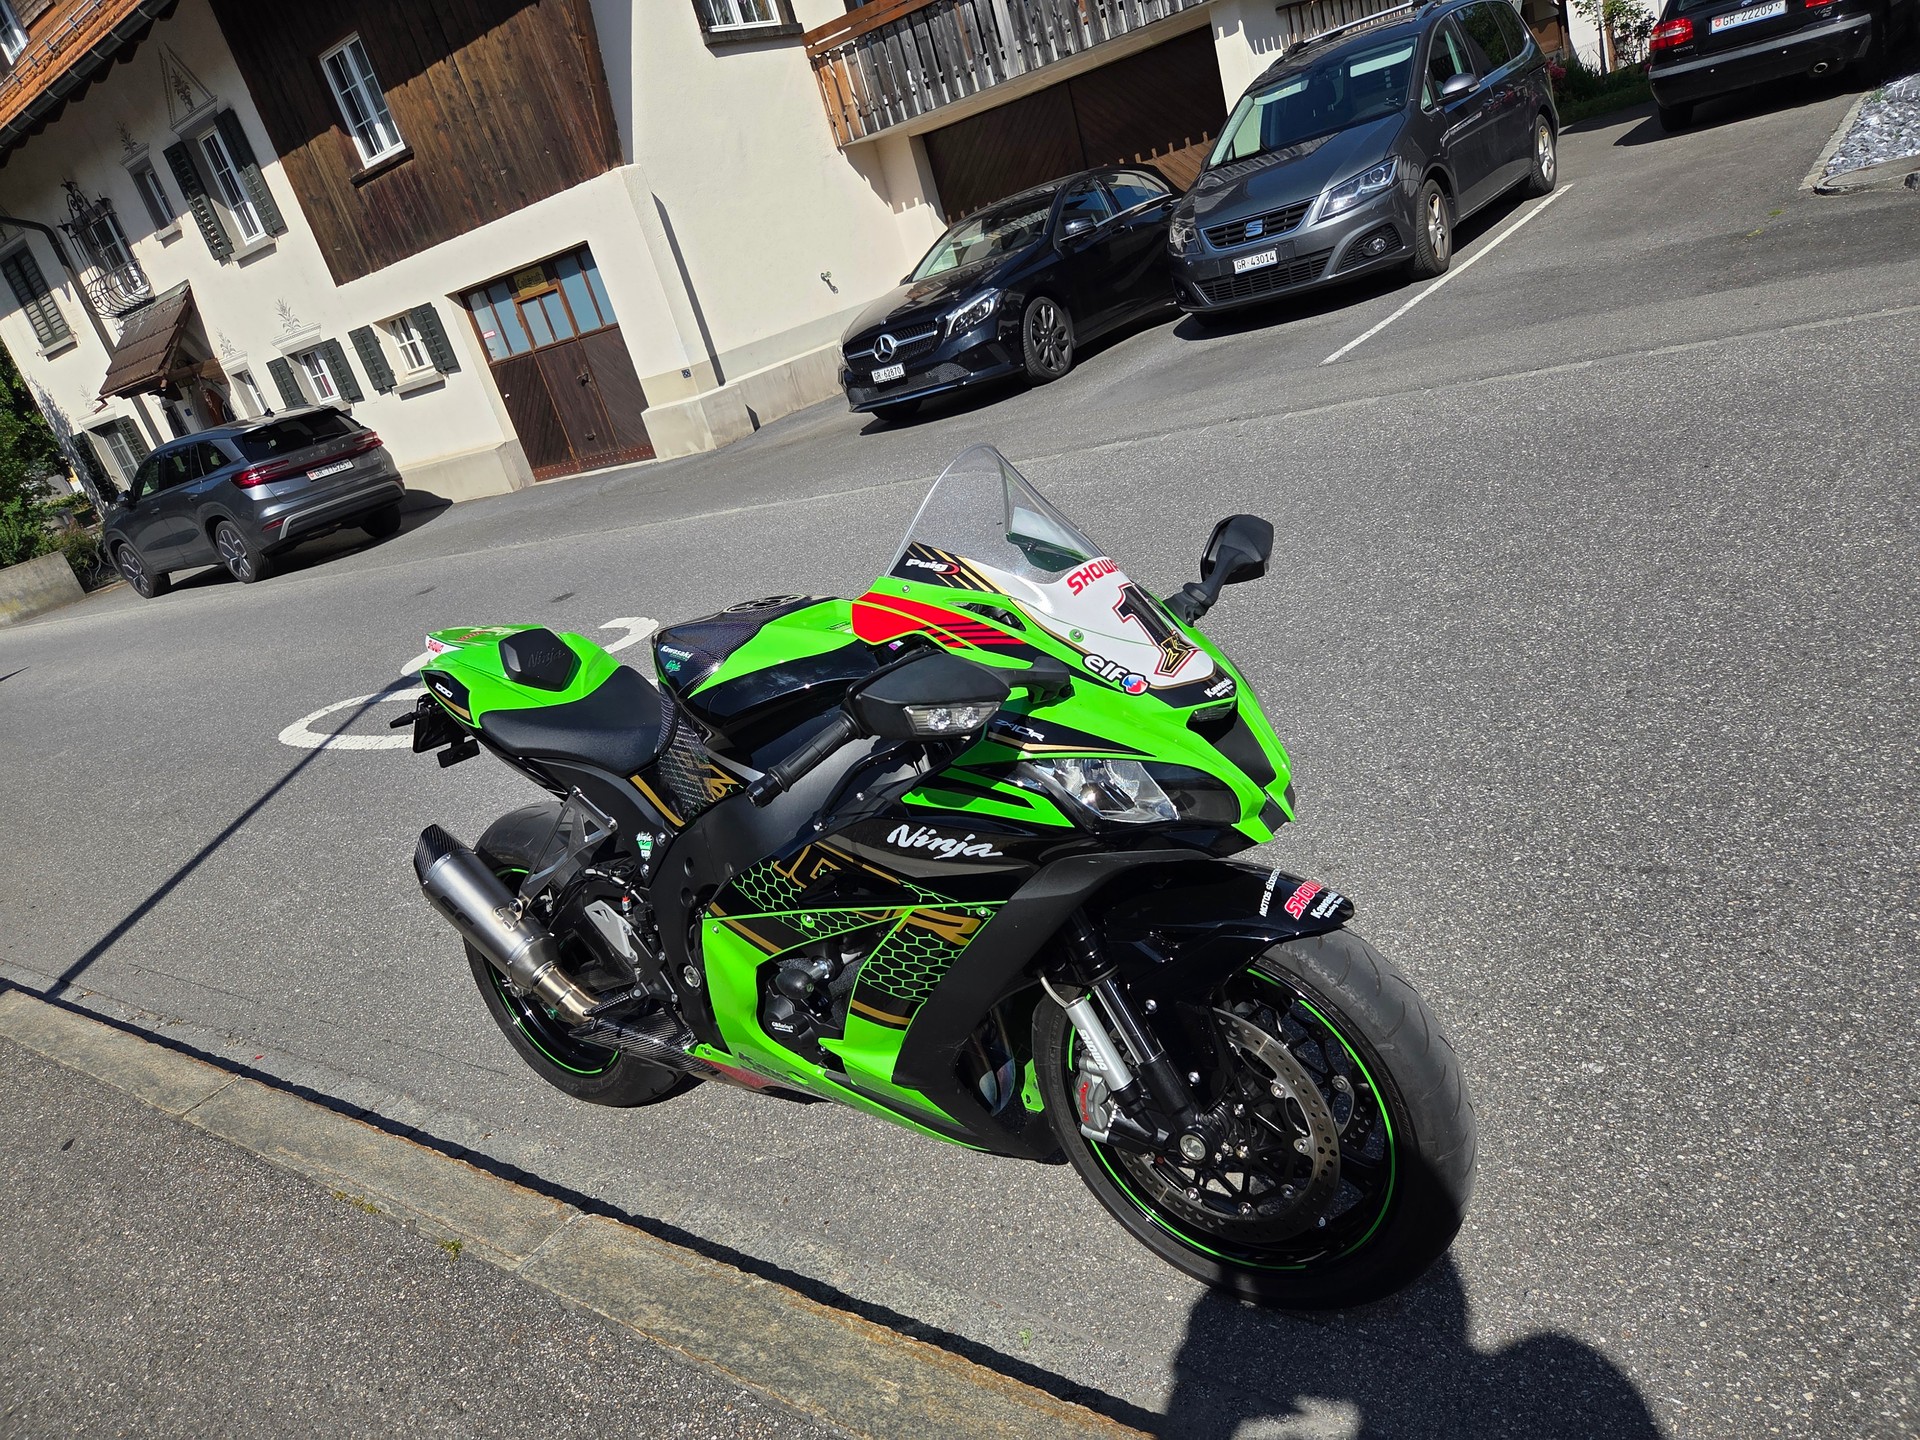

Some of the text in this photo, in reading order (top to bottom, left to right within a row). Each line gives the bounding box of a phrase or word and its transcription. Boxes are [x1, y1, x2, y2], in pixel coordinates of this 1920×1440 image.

[1741, 5, 1774, 22] 22209
[1250, 253, 1275, 265] 43014
[905, 558, 949, 572] Puig
[1083, 654, 1129, 682] elf
[886, 824, 1003, 860] Ninja
[1079, 1029, 1109, 1071] SHOWA
